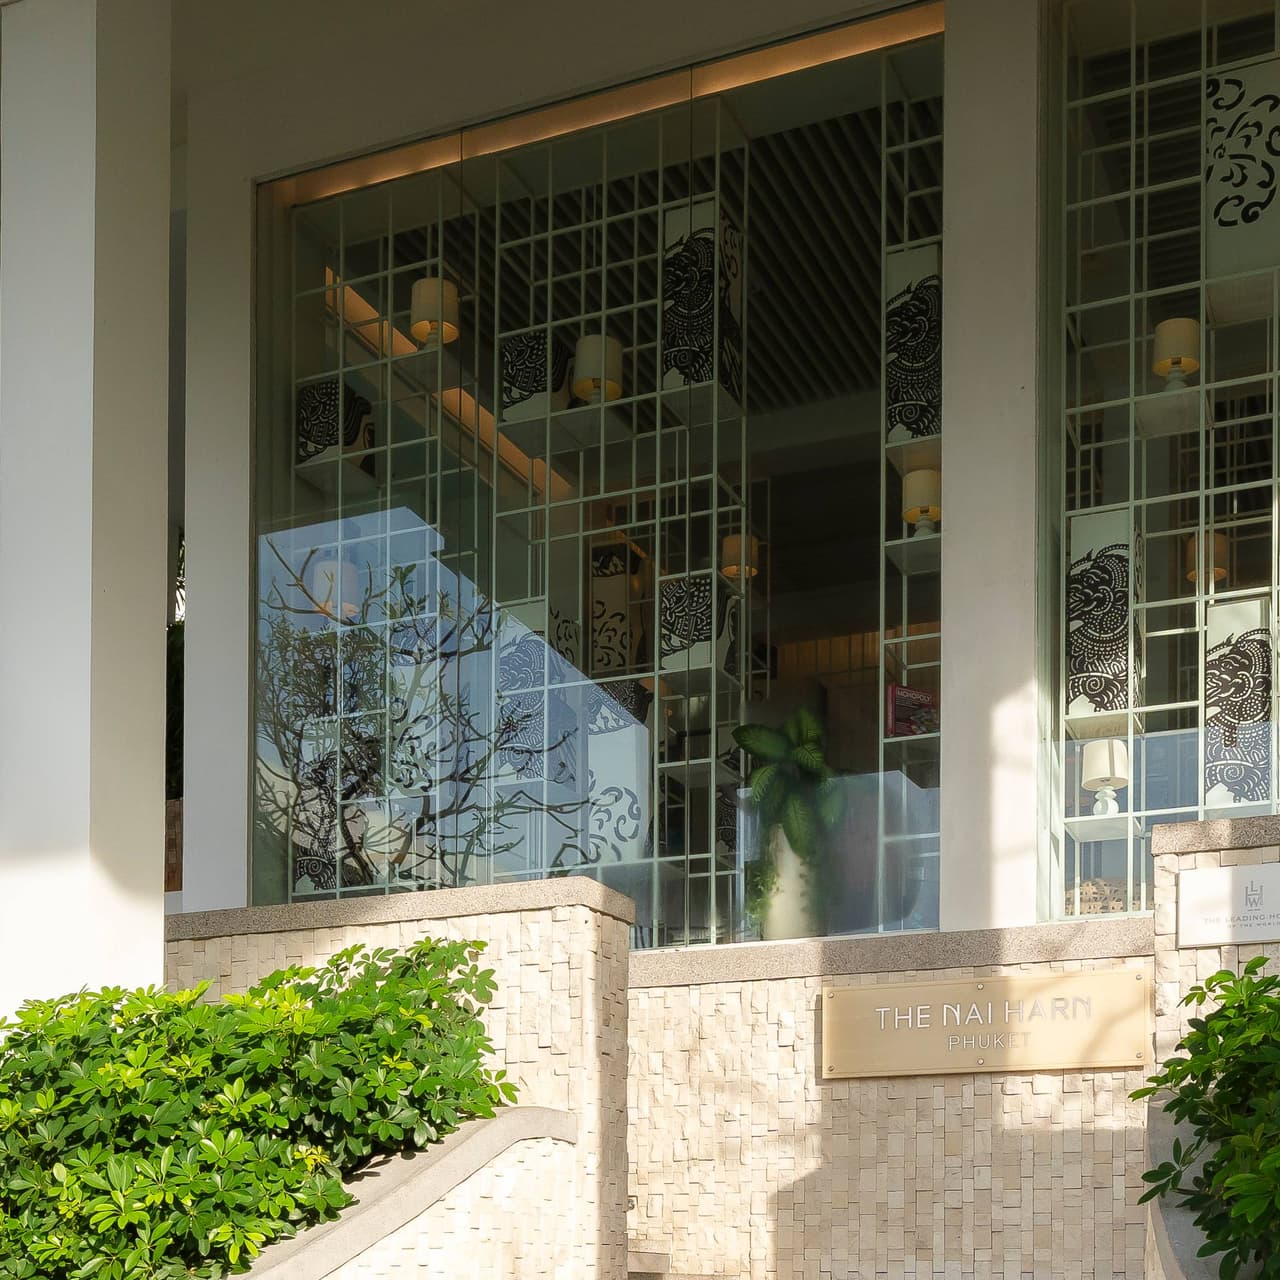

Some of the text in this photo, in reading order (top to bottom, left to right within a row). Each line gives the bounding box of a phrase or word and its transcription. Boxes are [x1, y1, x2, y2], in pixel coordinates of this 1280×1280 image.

[1225, 913, 1266, 923] LEADING
[875, 996, 1092, 1031] THE NAI HARN
[948, 1031, 1033, 1051] PHUKET
